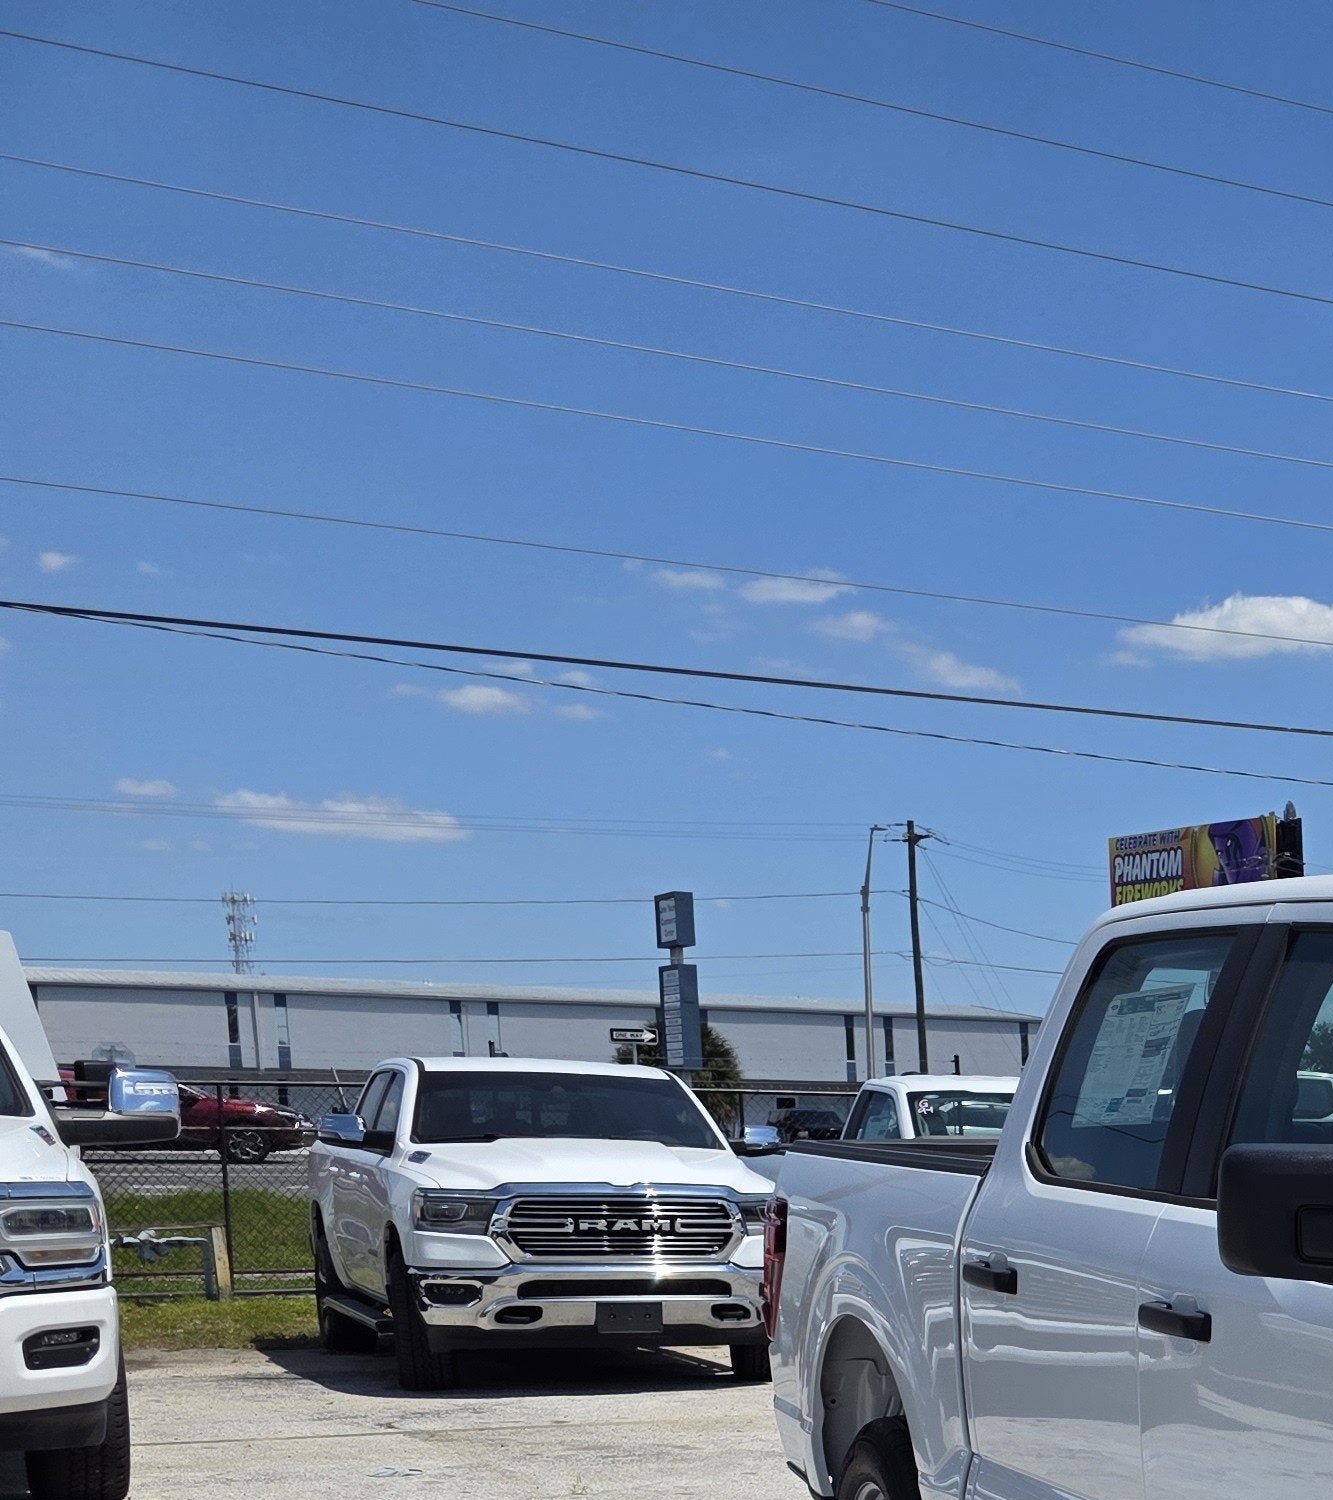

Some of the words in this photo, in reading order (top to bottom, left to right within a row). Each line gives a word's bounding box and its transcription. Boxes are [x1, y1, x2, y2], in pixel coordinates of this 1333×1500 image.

[1115, 834, 1157, 851] CELEBRATE
[1160, 830, 1180, 845] WITH
[1114, 848, 1182, 884] PHANTOM
[579, 1219, 671, 1231] RAM
